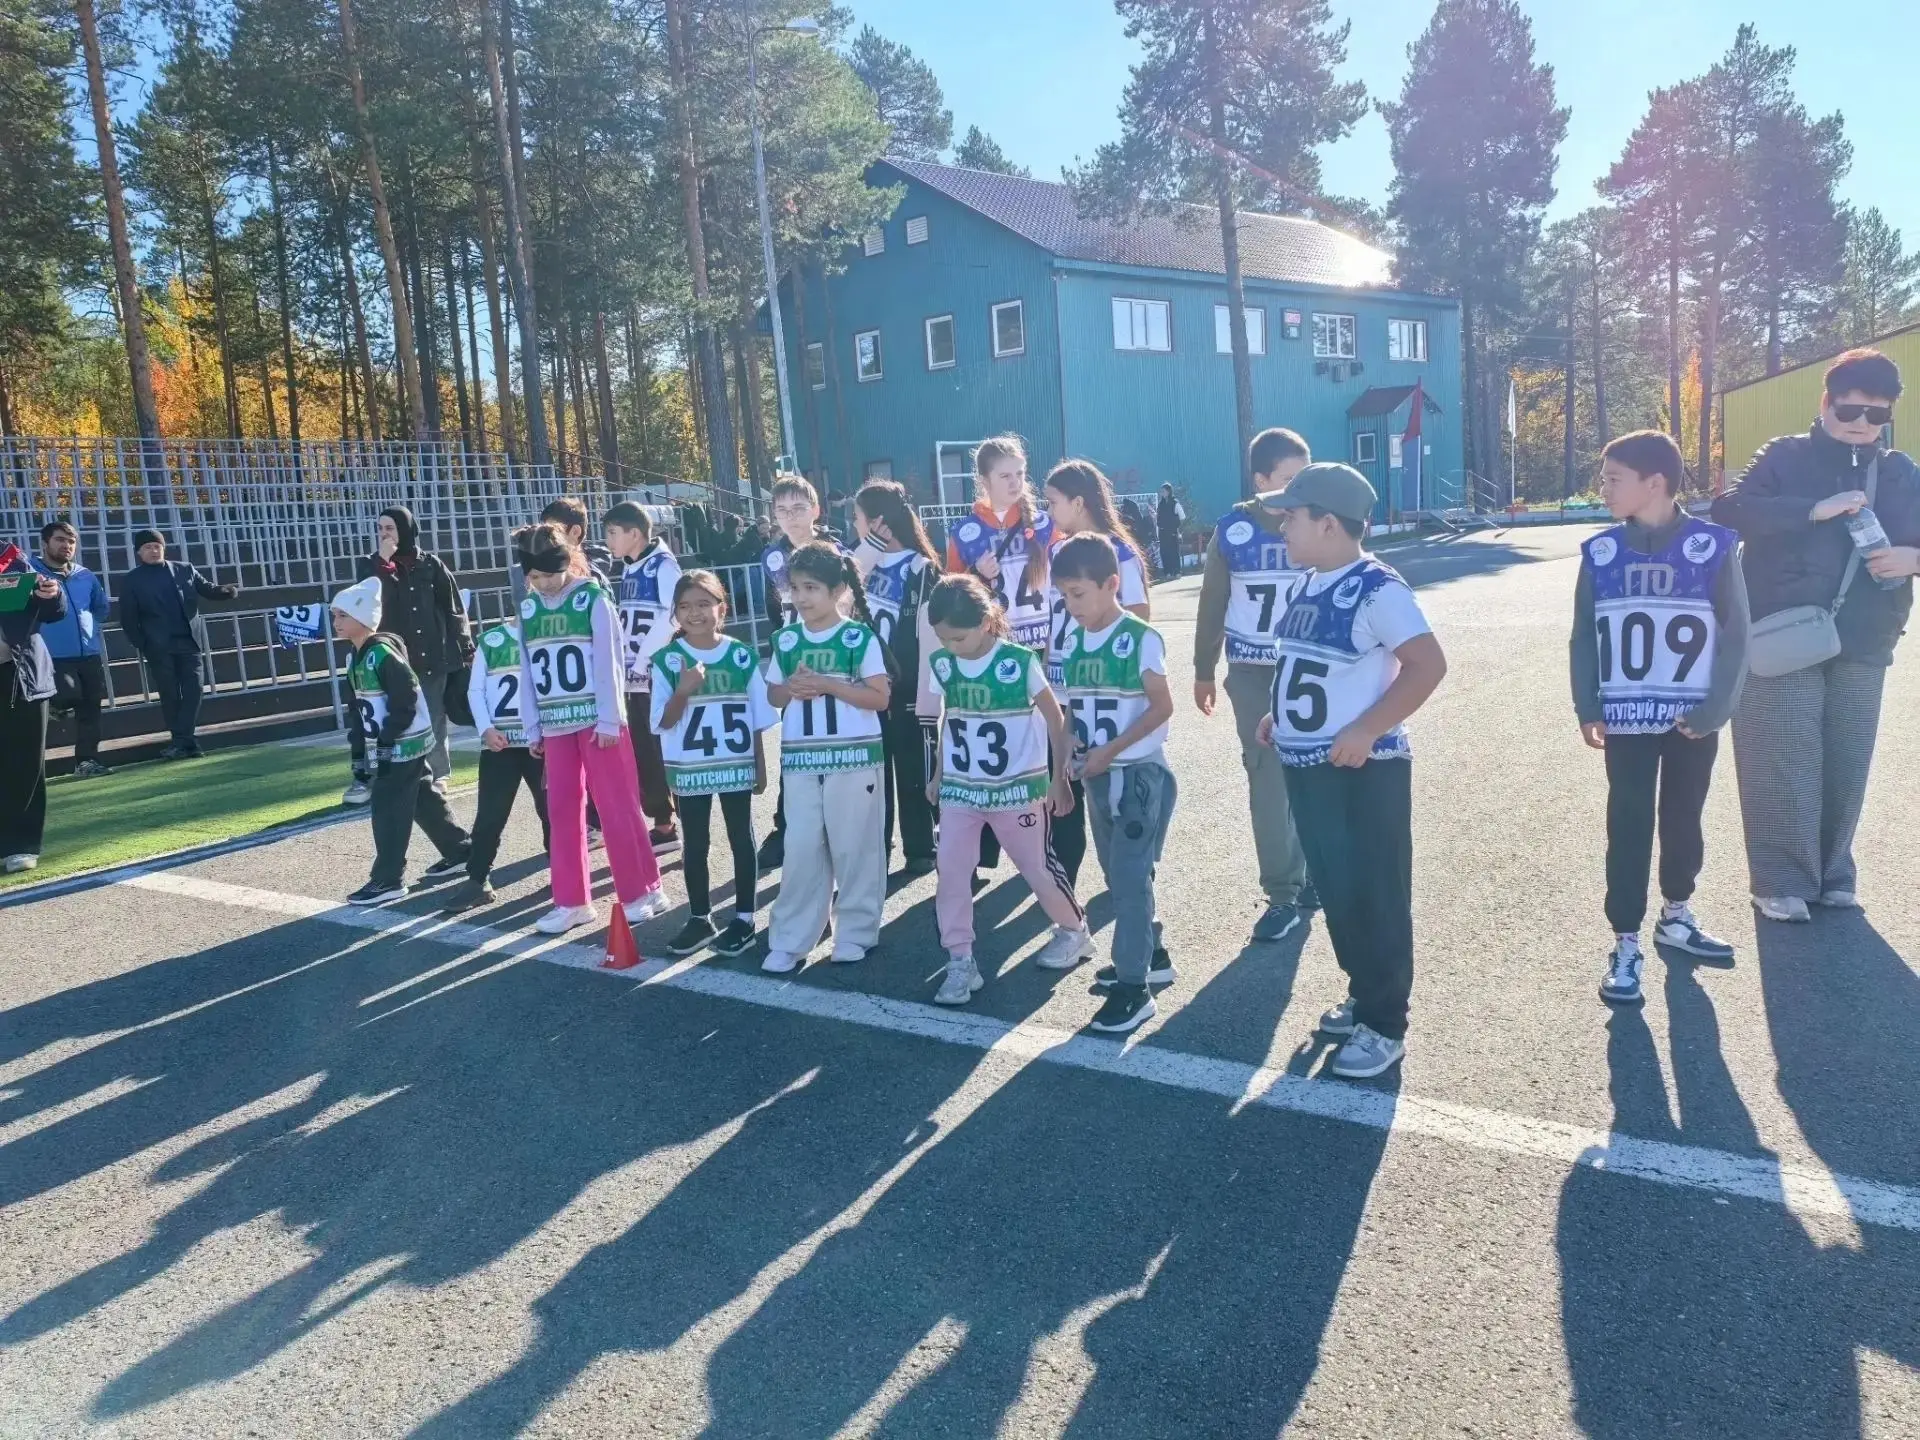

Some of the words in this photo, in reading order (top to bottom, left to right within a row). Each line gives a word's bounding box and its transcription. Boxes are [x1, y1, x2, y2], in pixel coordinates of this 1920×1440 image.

[532, 645, 586, 695] 30
[1597, 611, 1708, 683] 109
[683, 703, 752, 756] 45
[948, 718, 1009, 776] 53
